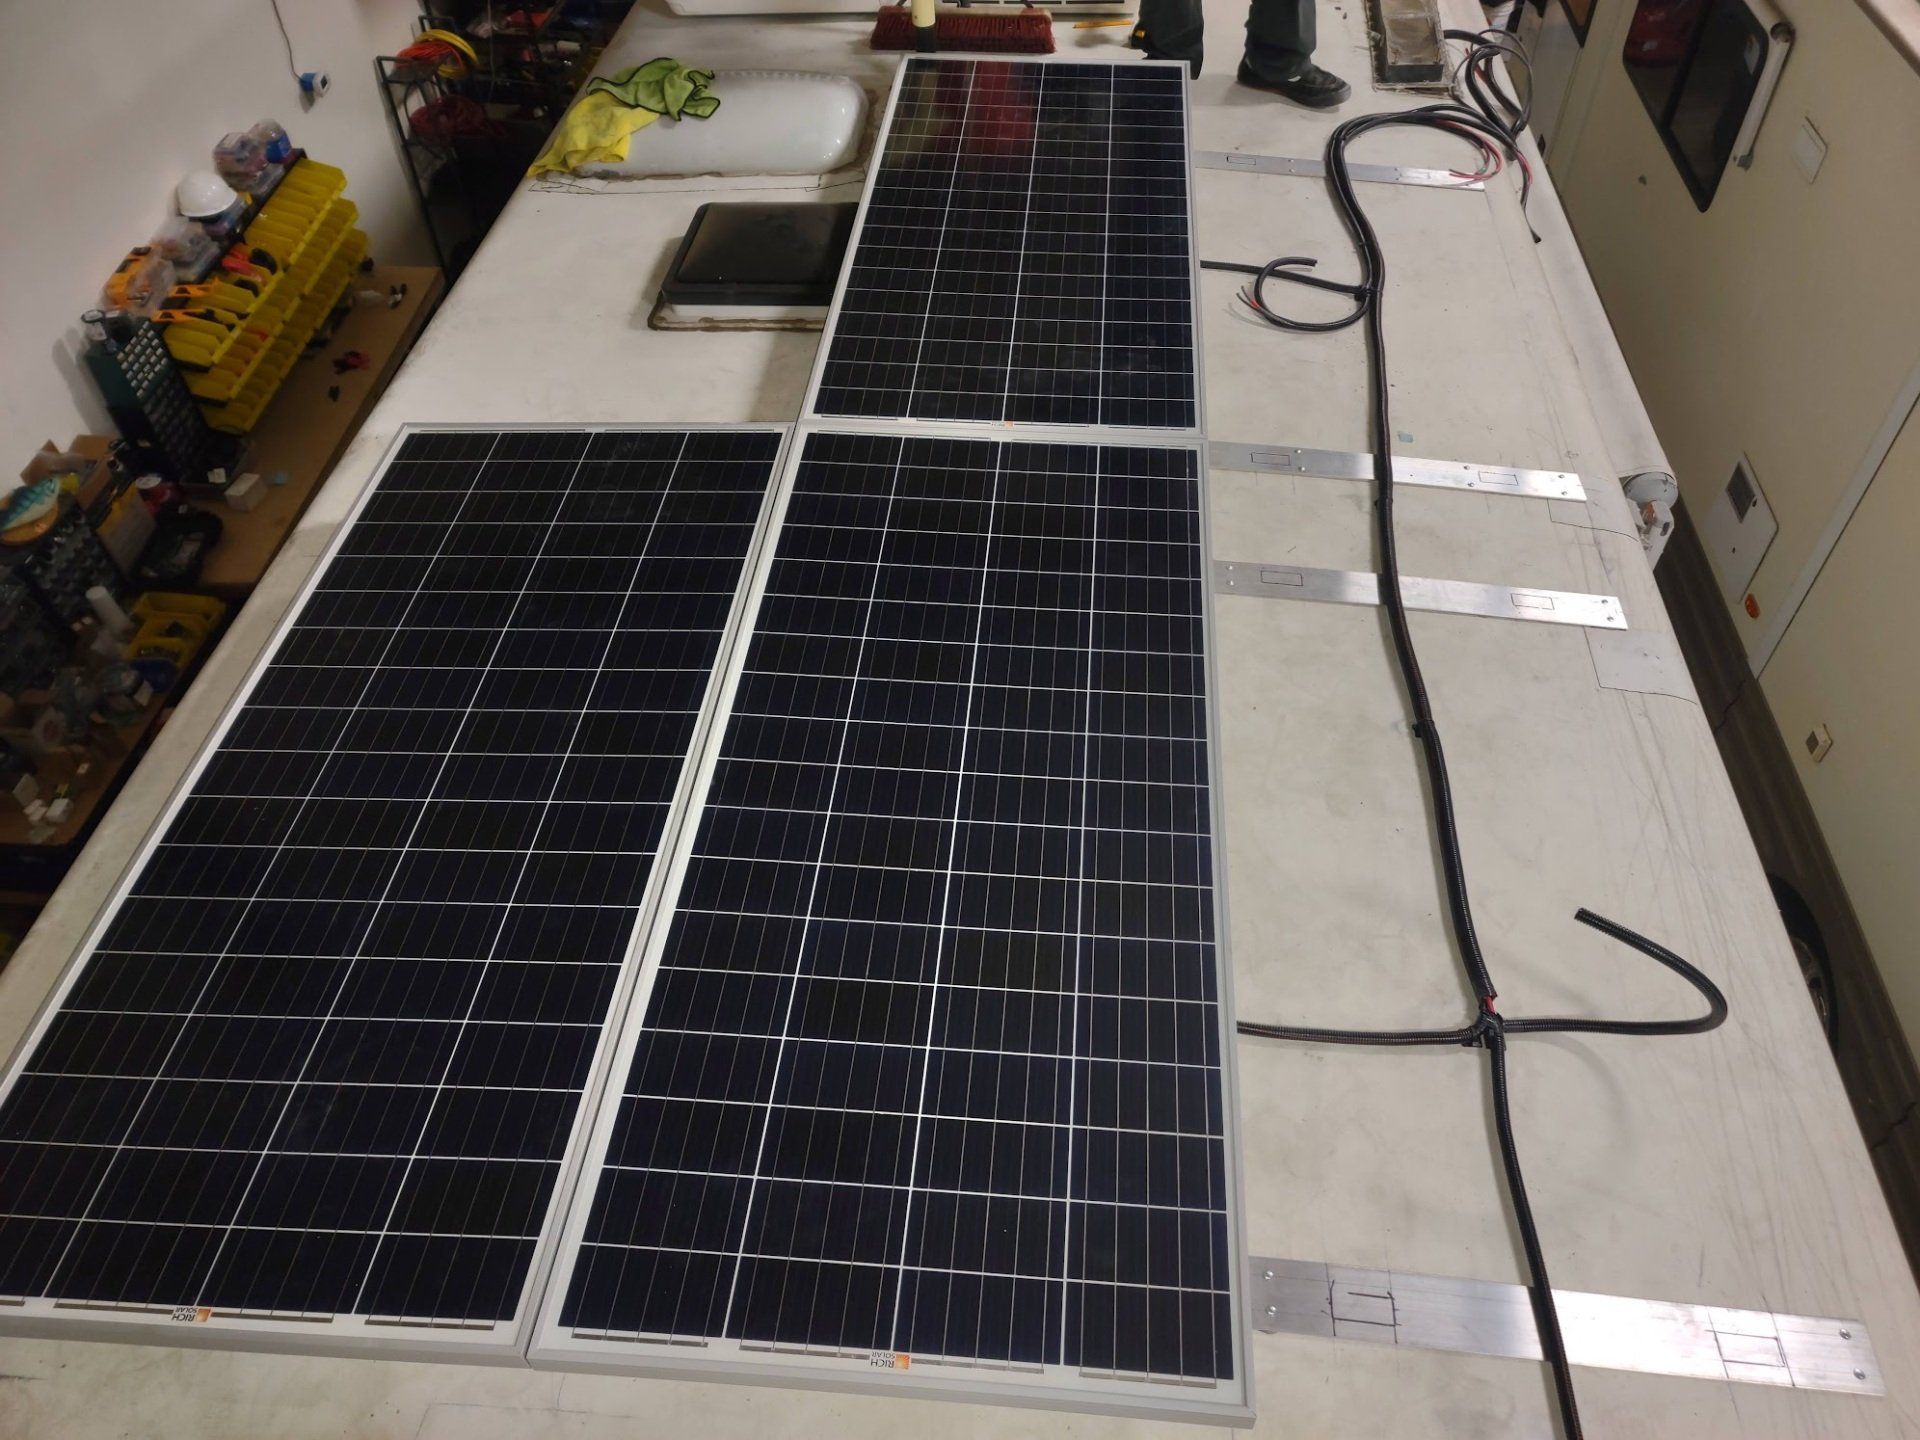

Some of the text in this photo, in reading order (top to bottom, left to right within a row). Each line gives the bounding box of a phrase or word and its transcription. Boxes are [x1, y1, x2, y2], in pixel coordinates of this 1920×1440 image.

[171, 1313, 196, 1322] RICH
[871, 1351, 896, 1359] SOLAR
[870, 1358, 895, 1369] RICH
